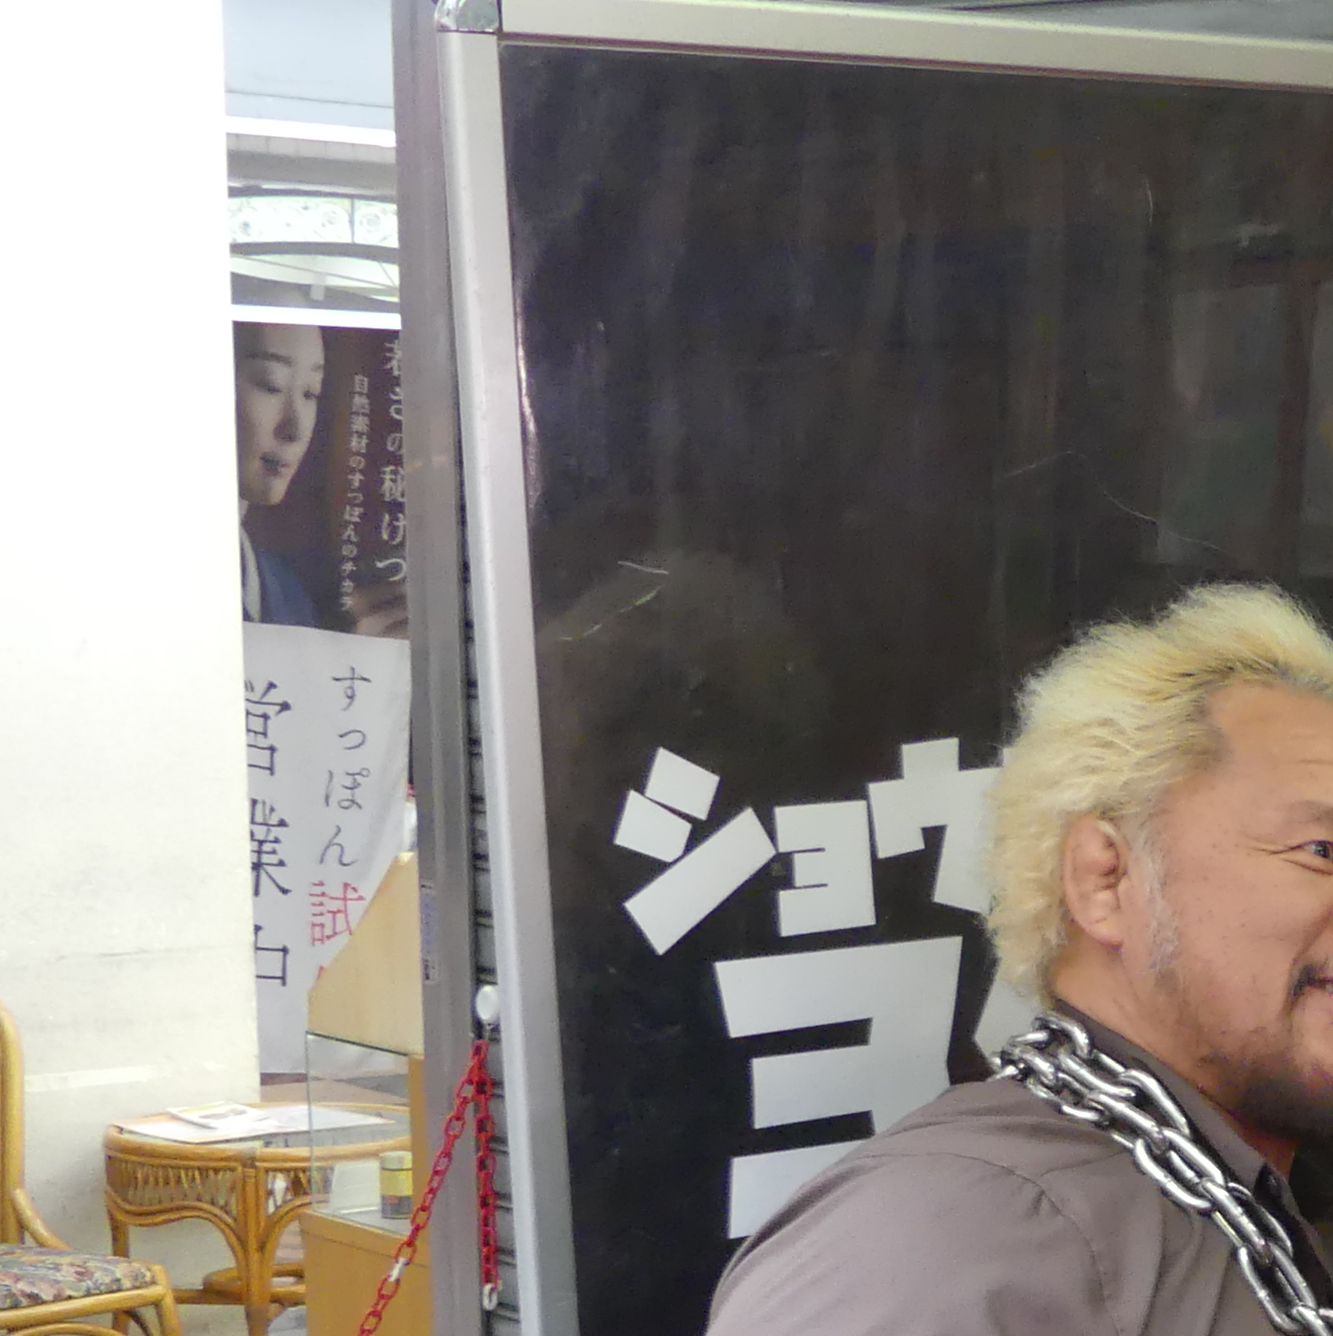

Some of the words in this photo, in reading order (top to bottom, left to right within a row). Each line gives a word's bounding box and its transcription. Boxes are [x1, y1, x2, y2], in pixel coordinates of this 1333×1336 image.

[308, 666, 373, 981] すっぽん試
